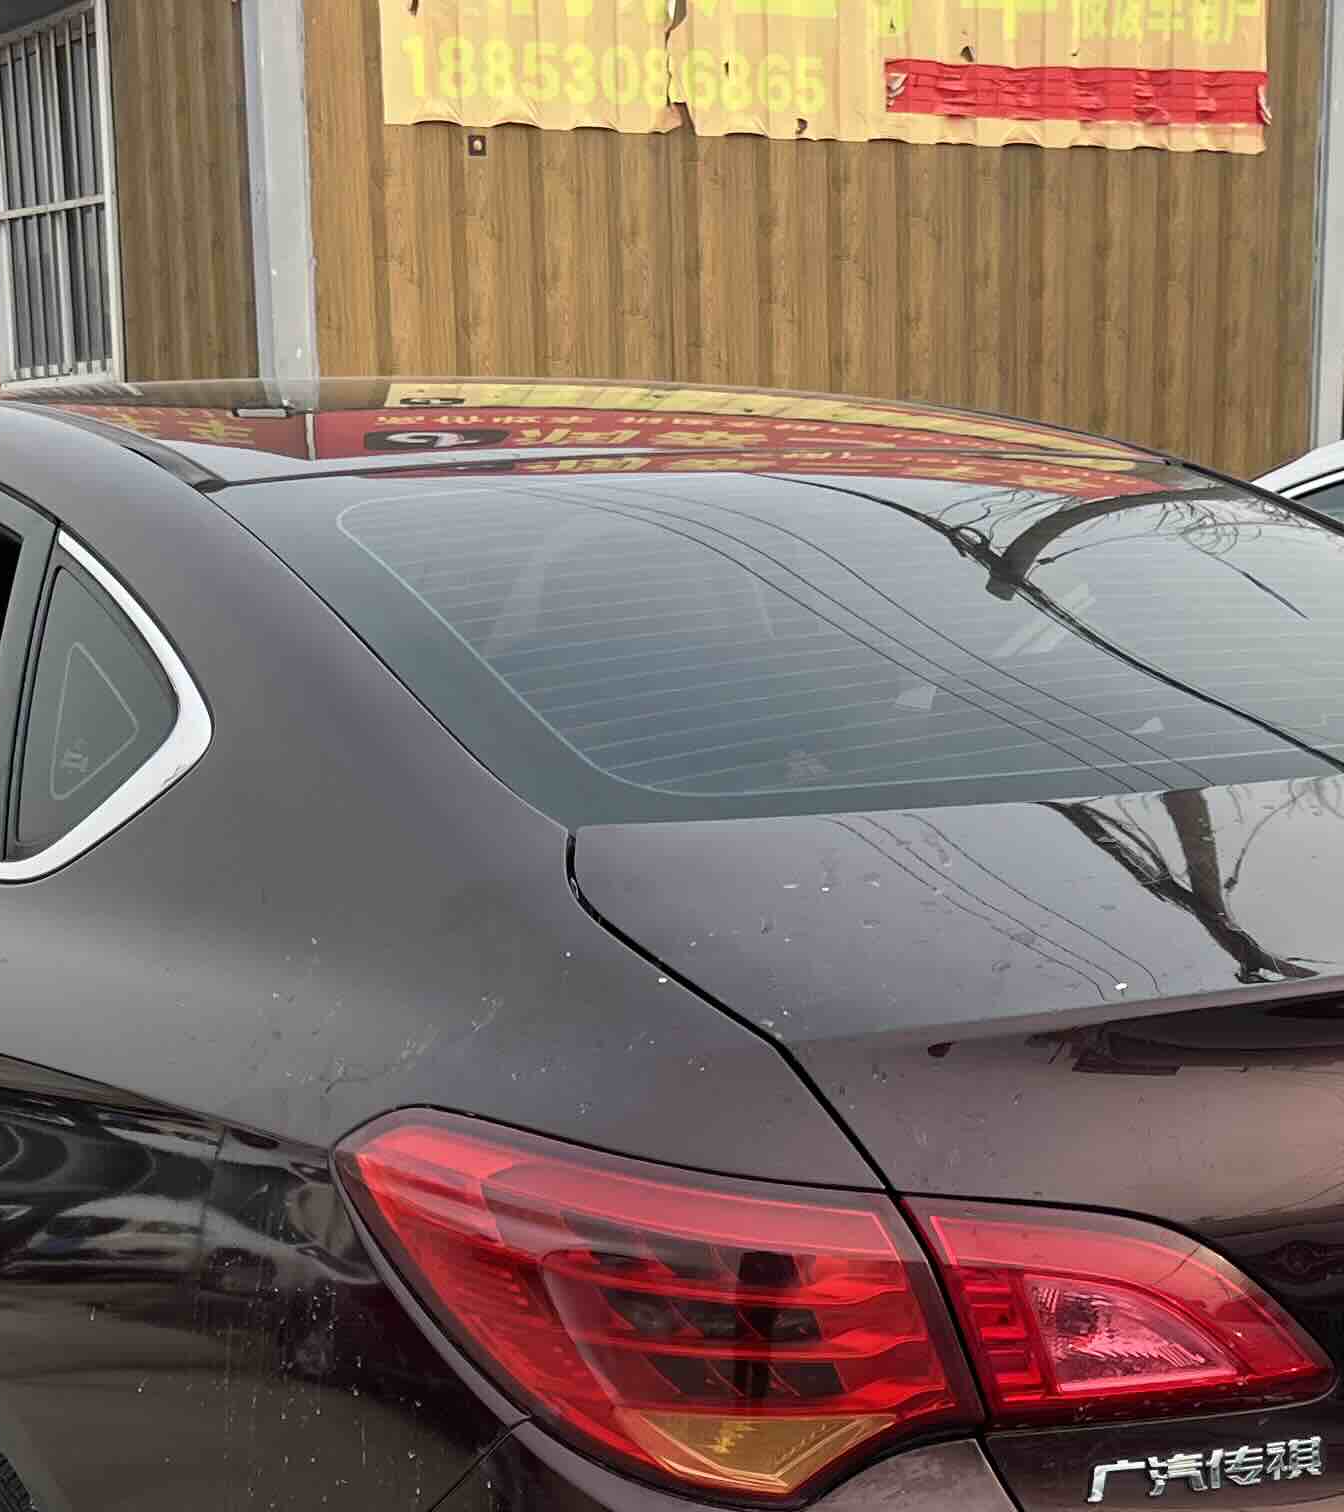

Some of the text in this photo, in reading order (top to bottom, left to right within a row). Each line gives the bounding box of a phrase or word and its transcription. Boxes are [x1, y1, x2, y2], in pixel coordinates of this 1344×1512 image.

[401, 33, 826, 113] 18853086865
[1087, 1435, 1323, 1503] 广汽传祺
